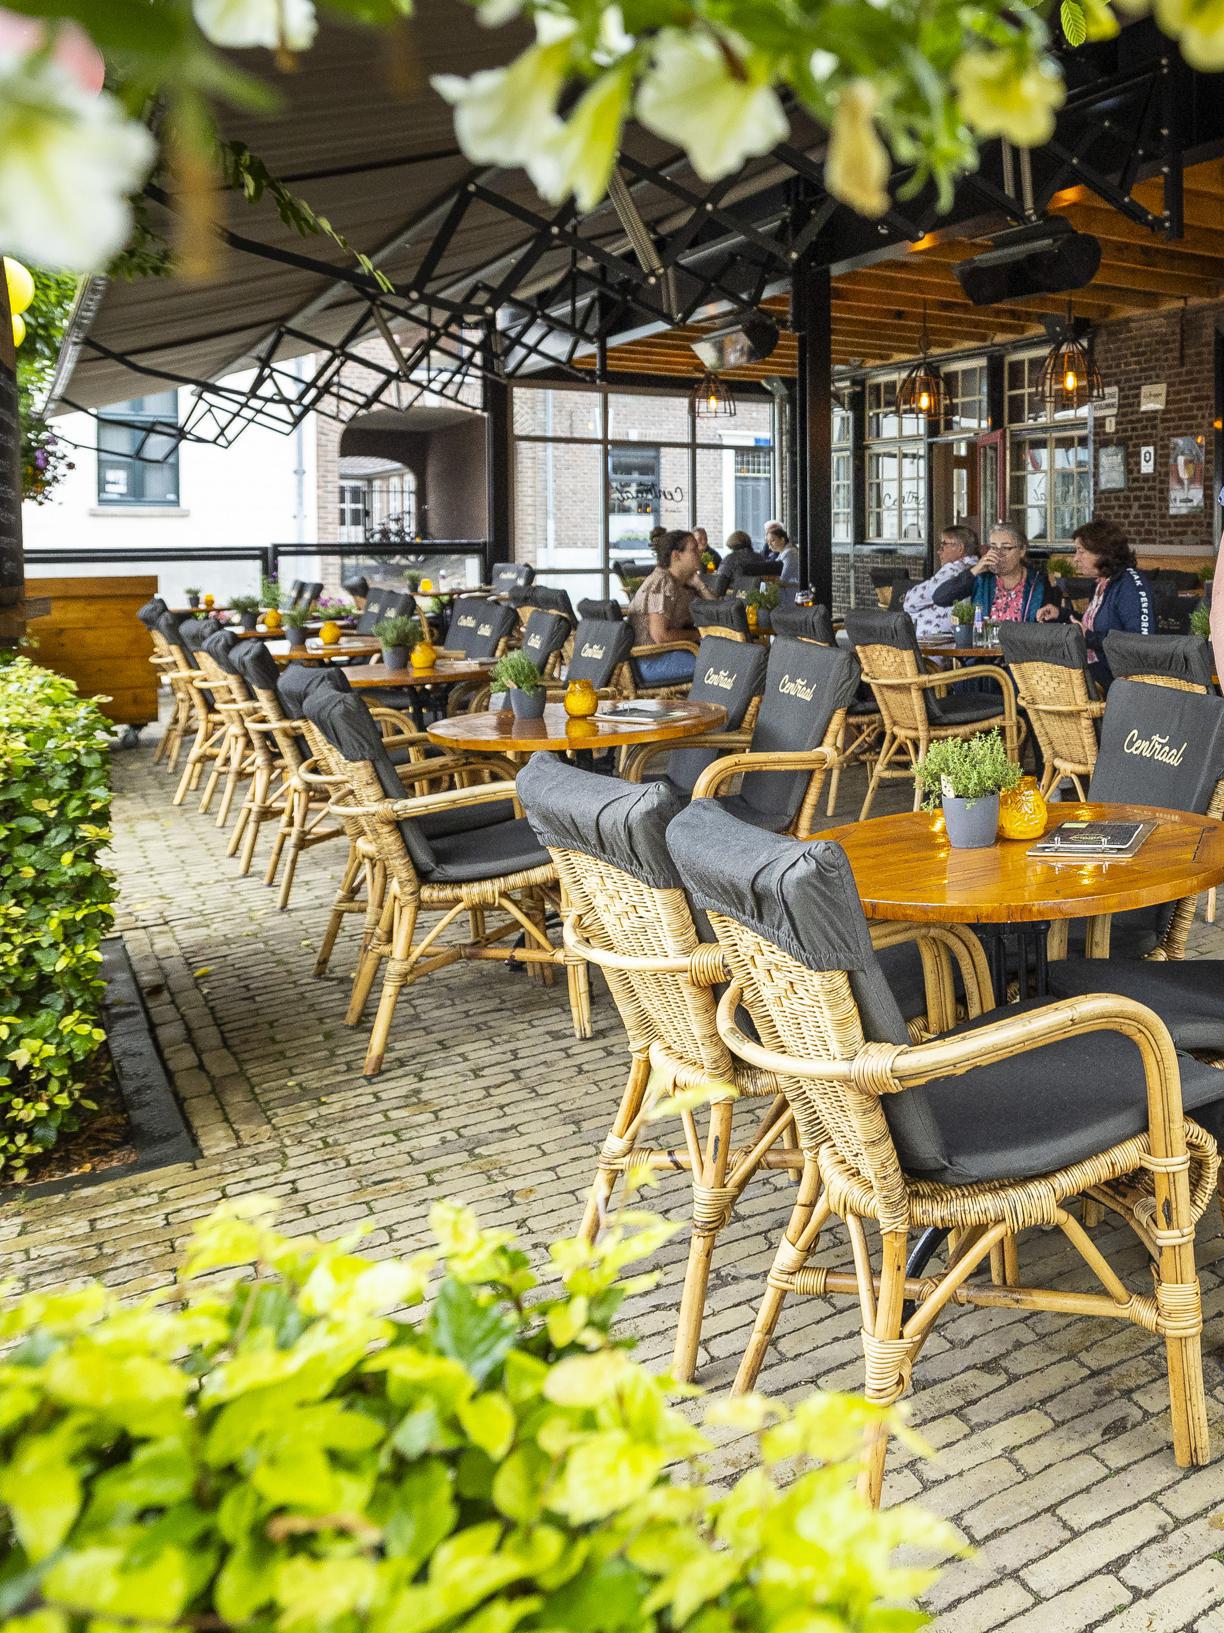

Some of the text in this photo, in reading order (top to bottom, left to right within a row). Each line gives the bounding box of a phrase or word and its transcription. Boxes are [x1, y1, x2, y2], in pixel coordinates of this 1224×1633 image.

[704, 667, 737, 690] Centraal
[779, 674, 817, 702] Centraal
[1124, 729, 1188, 767] Centraal
